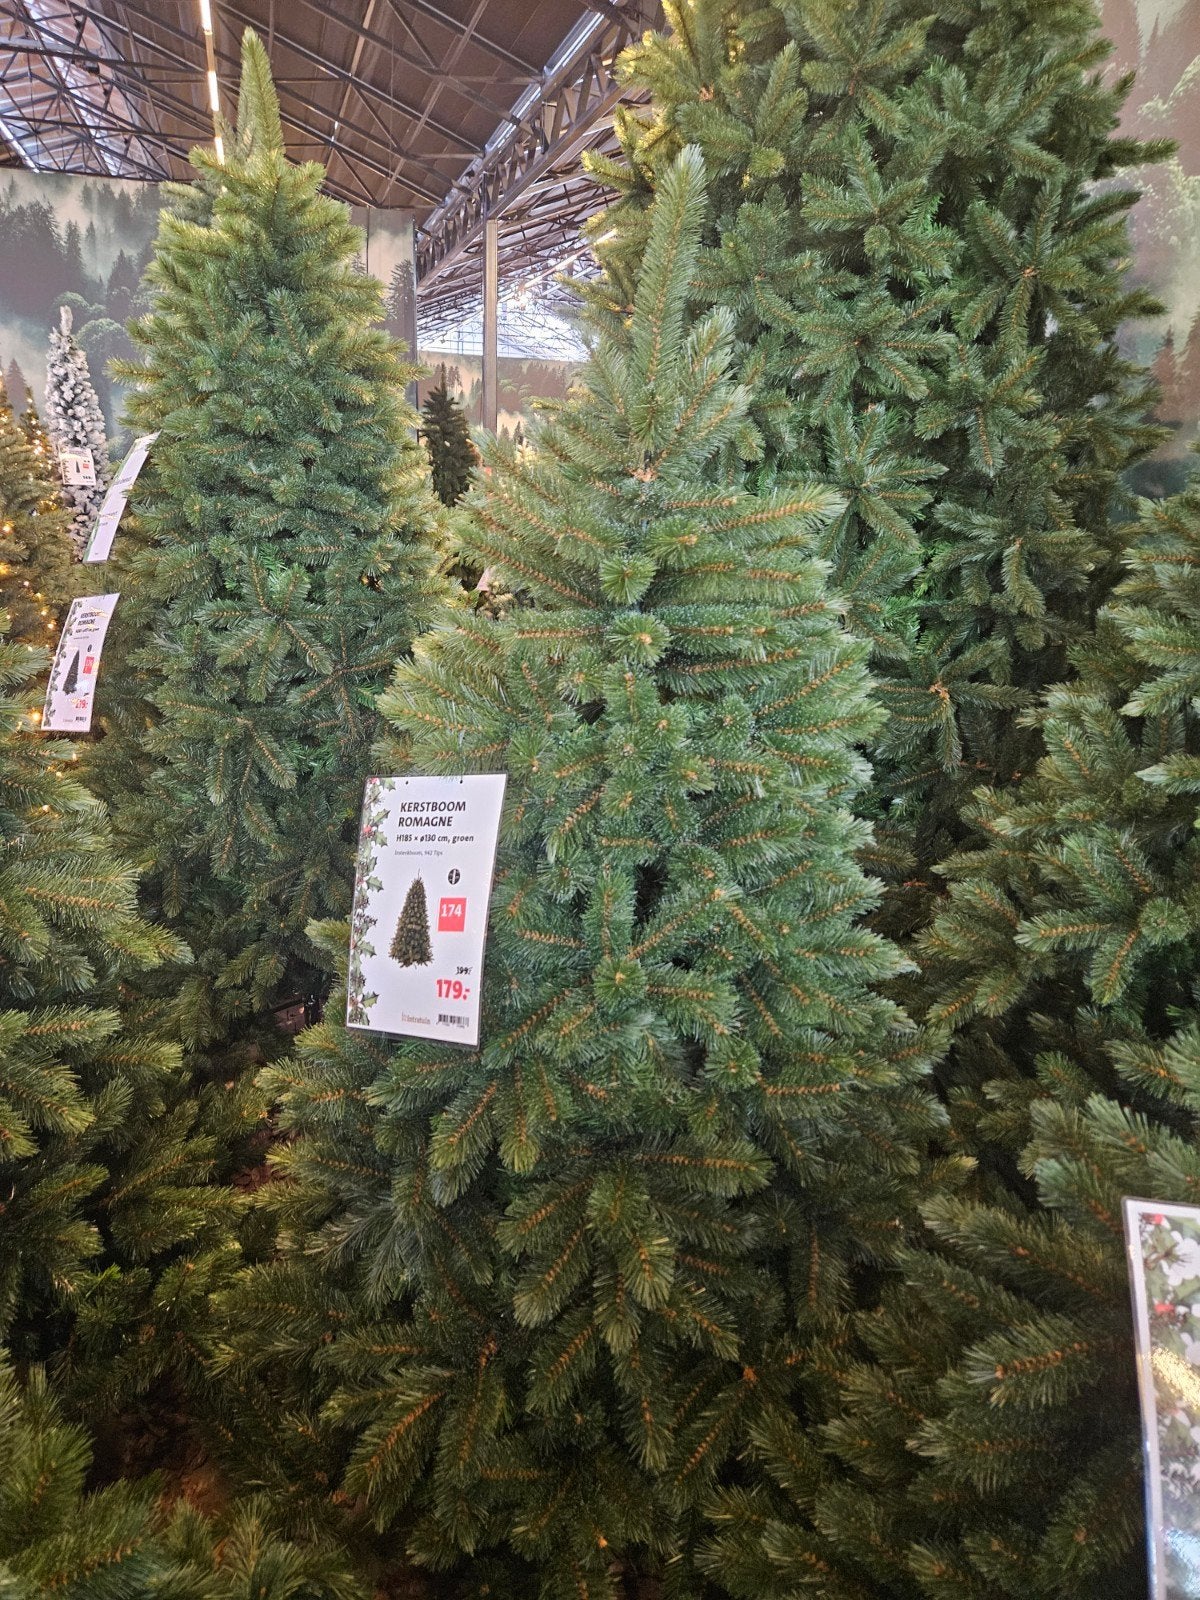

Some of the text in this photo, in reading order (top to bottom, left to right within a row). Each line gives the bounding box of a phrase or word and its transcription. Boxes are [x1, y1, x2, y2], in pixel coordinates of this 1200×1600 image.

[400, 801, 466, 813] KERSTBOOM
[398, 816, 453, 827] ROMAGNE
[396, 834, 413, 842] H185
[437, 835, 450, 844] cm,
[452, 835, 474, 844] groen
[441, 903, 462, 917] 174
[436, 979, 470, 1000] 179.-
